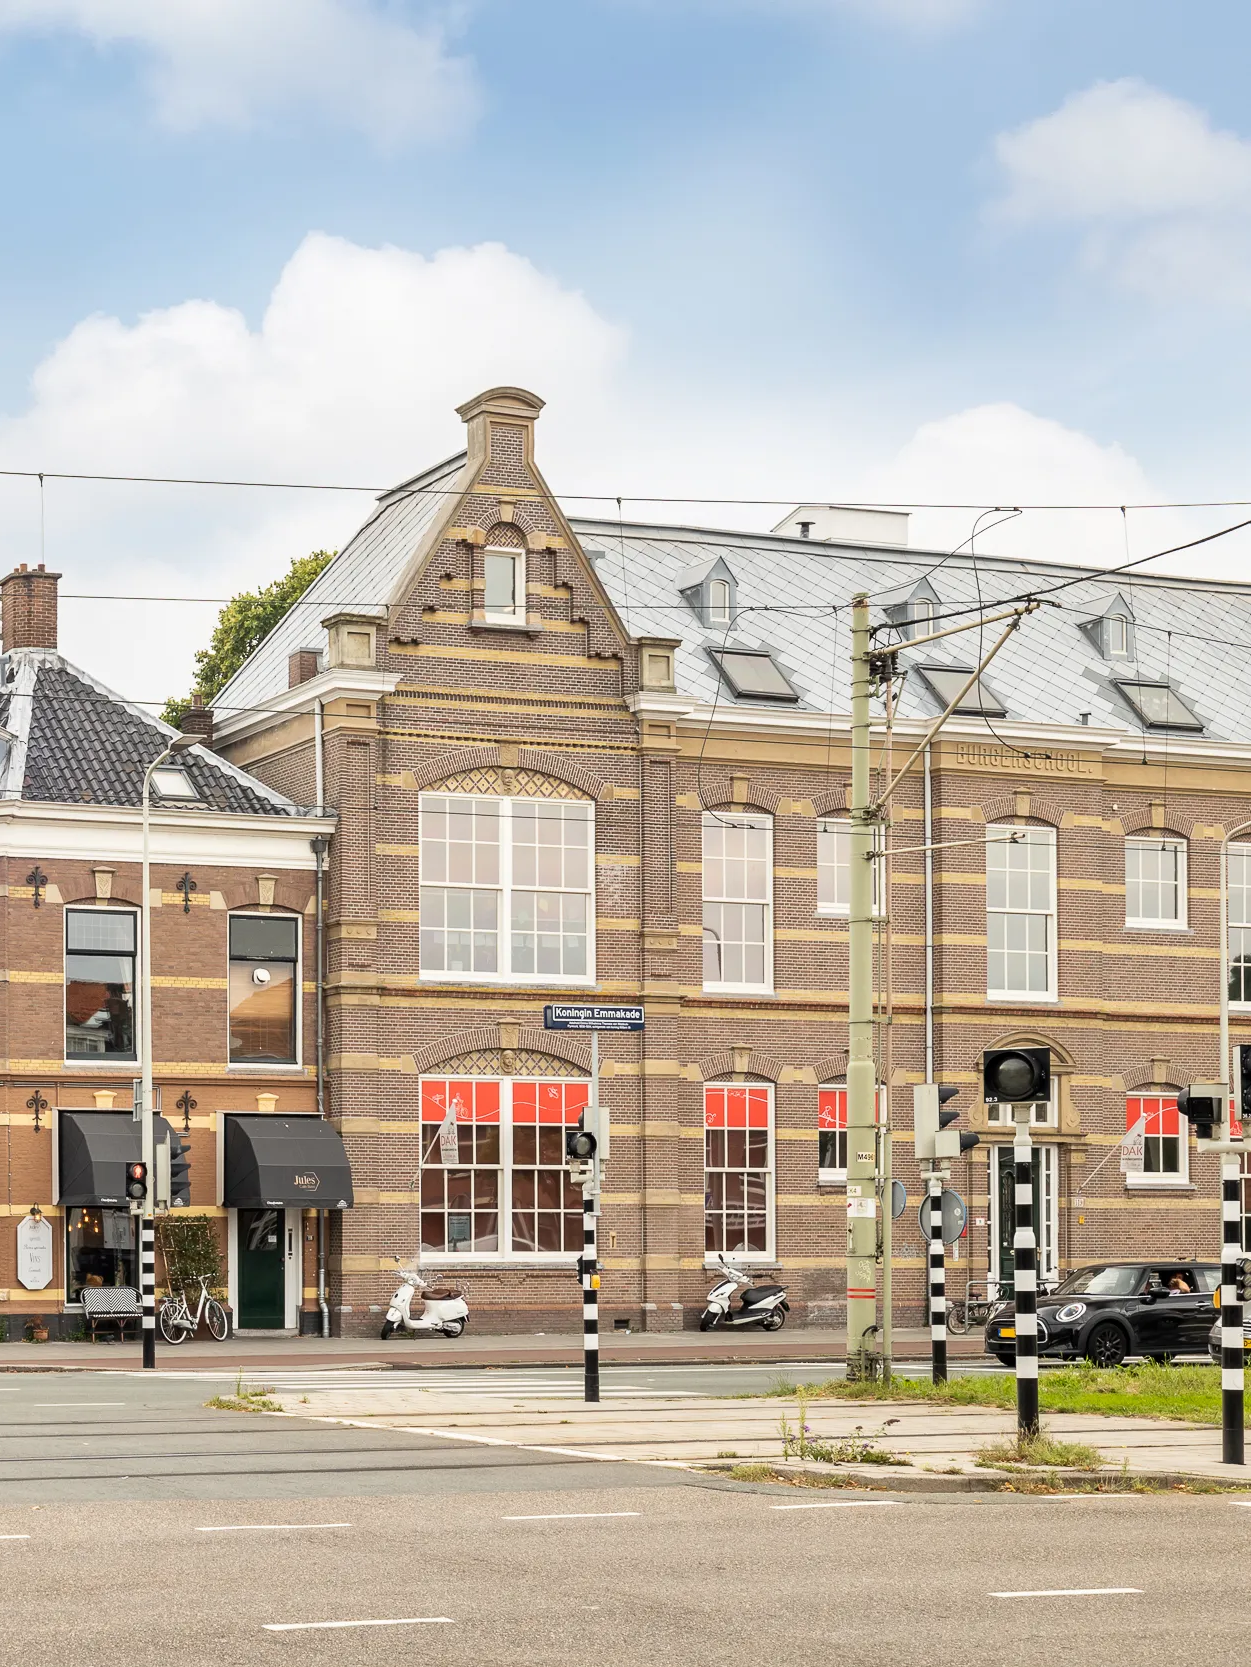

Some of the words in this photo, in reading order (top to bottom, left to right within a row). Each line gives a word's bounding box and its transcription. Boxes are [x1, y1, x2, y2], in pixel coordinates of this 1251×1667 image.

[555, 1007, 592, 1020] Koningin
[594, 1008, 641, 1019] Emmakade
[441, 1135, 457, 1146] DAK
[1122, 1145, 1143, 1156] DAK
[293, 1175, 316, 1186] Jules
